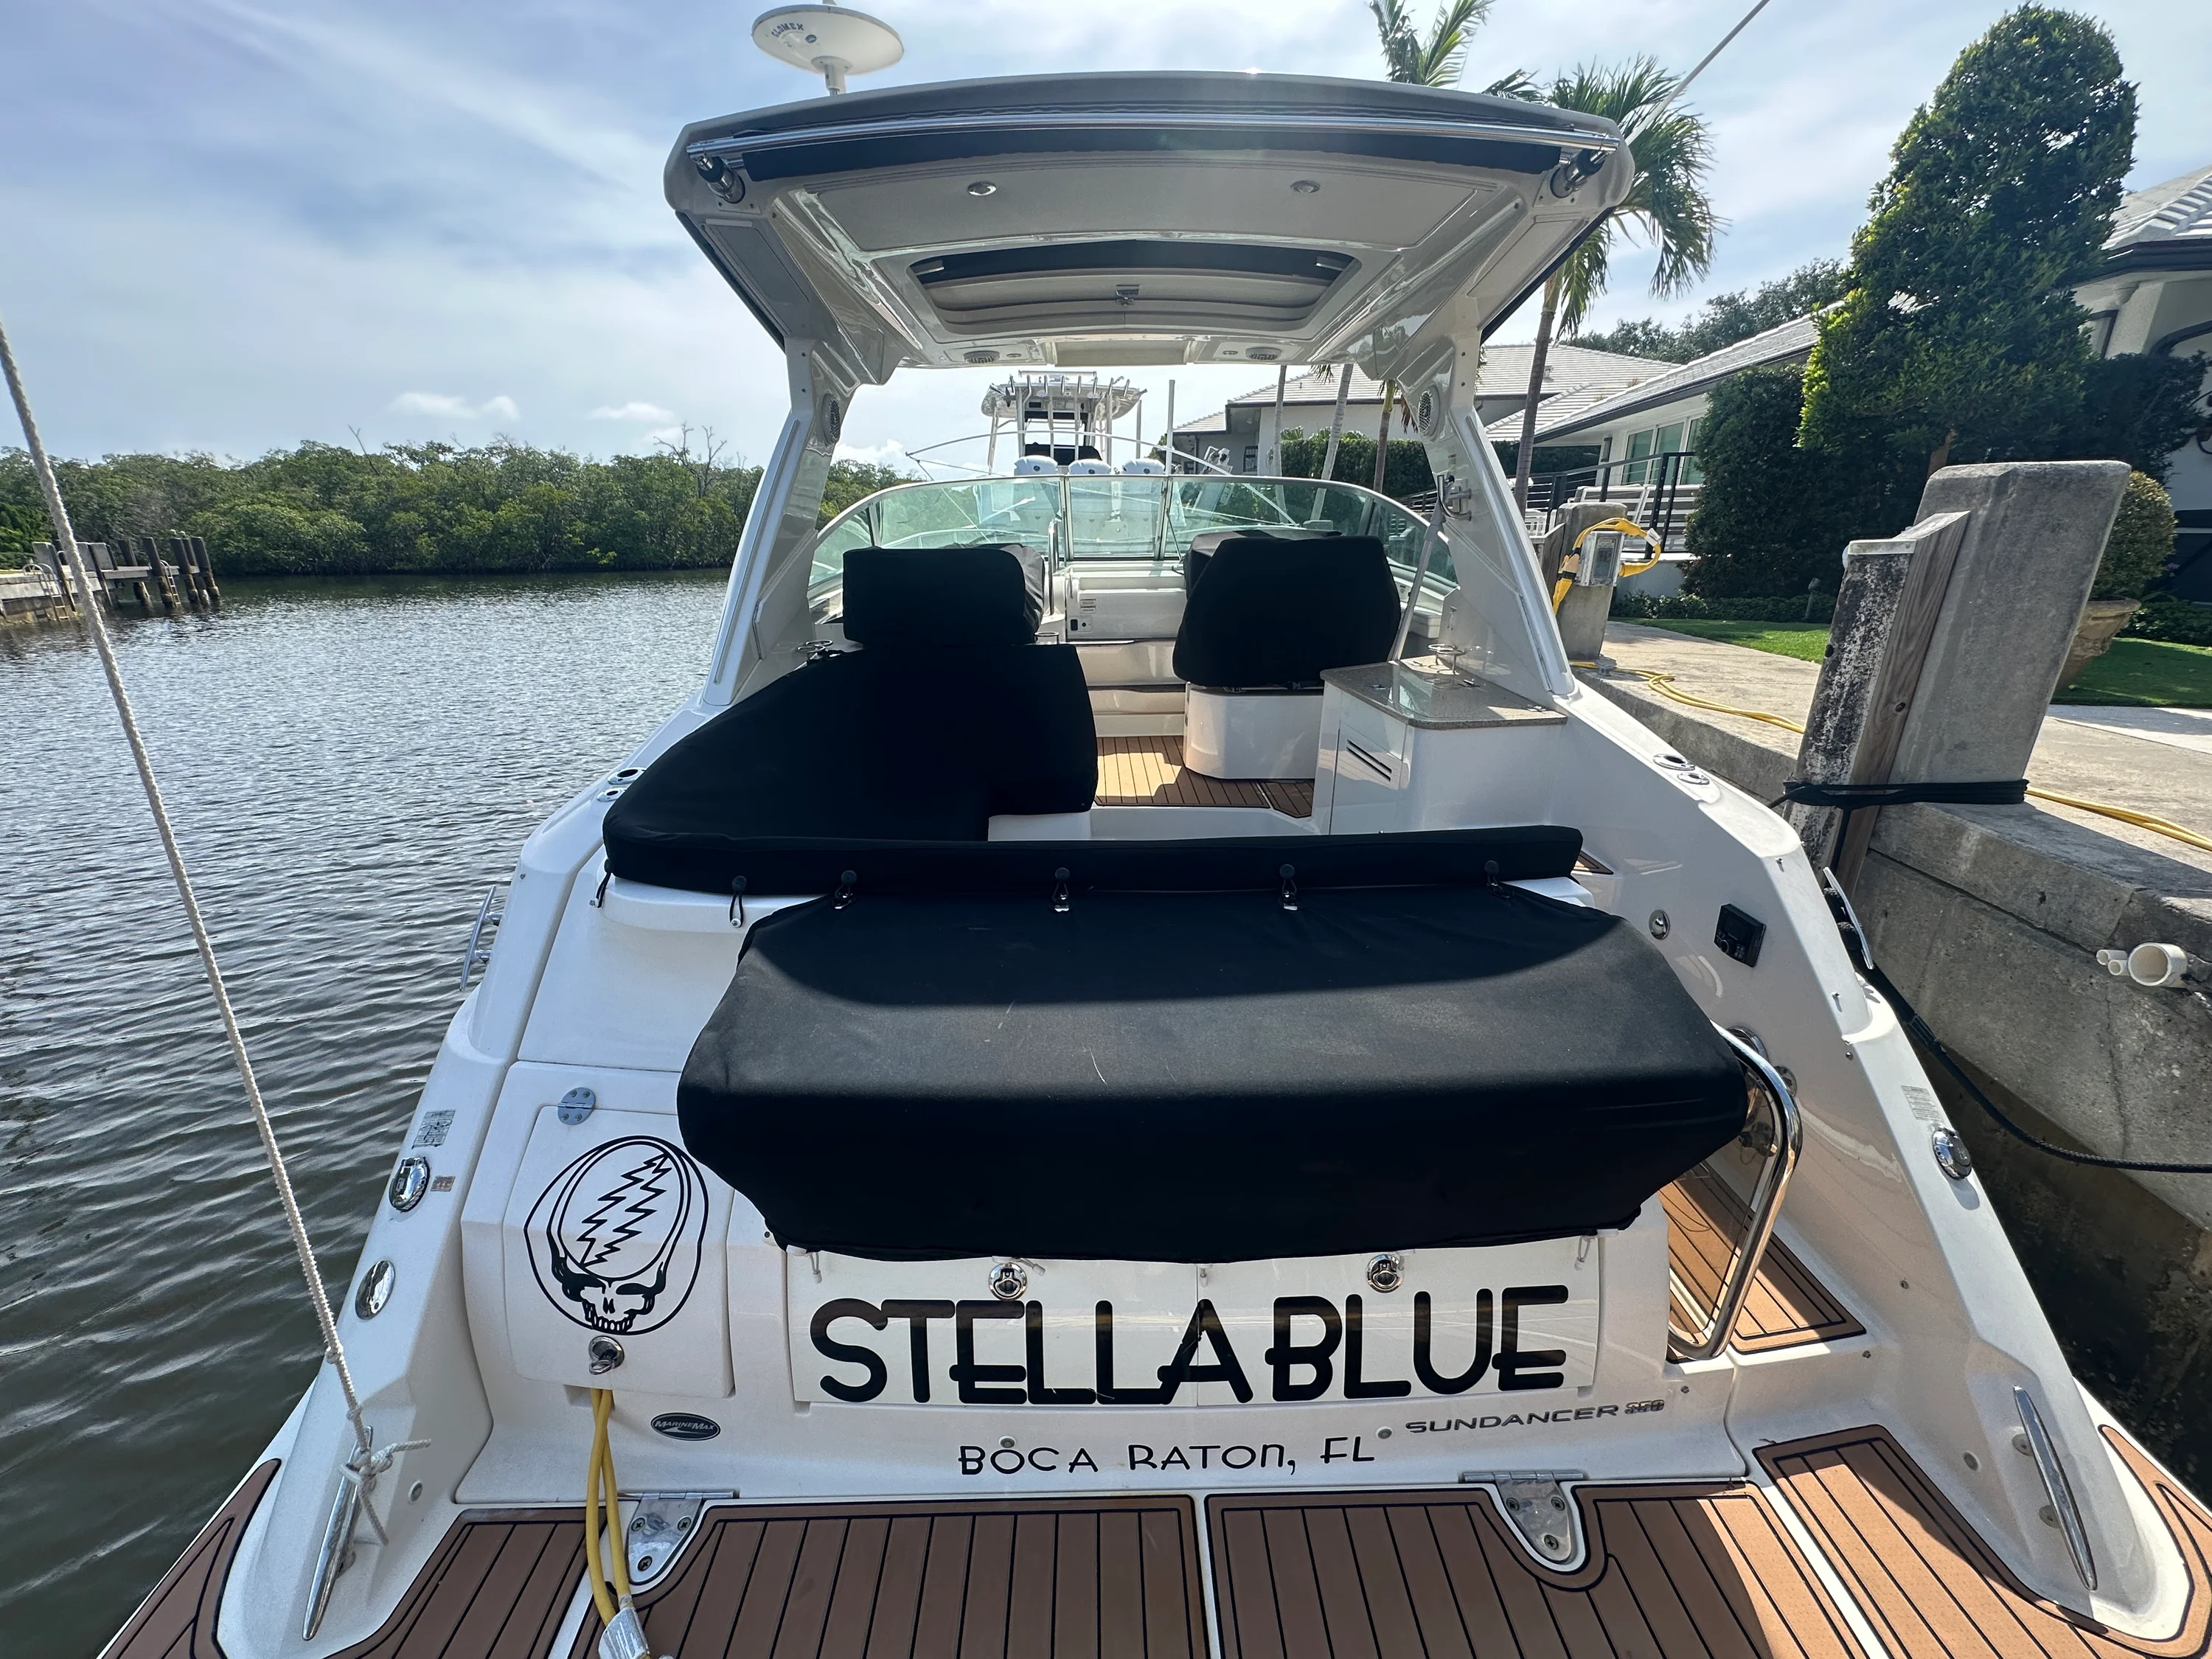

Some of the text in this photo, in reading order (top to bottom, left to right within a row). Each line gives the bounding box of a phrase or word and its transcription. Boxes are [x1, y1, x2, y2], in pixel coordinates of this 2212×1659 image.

[771, 22, 804, 38] GLOMEX
[1405, 1404, 1619, 1434] SUNDANCER
[957, 1444, 1099, 1476] BOCA
[1319, 1435, 1376, 1465] FL
